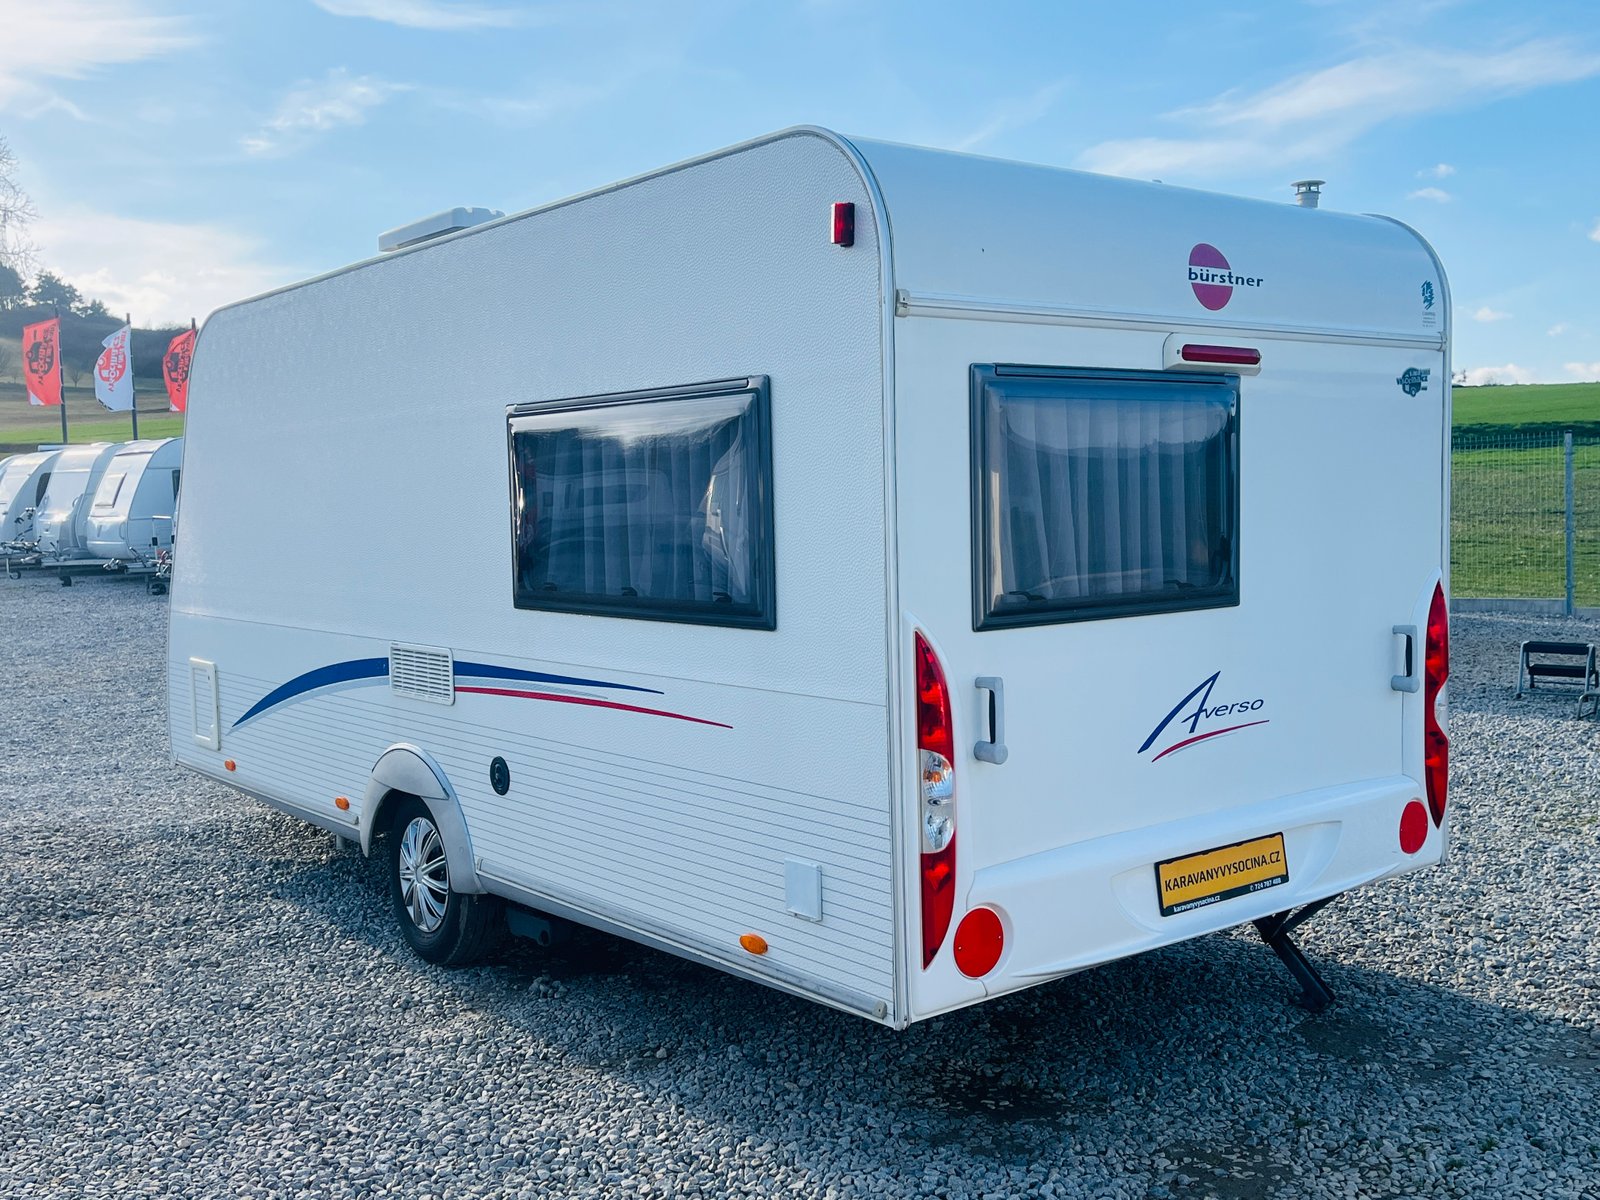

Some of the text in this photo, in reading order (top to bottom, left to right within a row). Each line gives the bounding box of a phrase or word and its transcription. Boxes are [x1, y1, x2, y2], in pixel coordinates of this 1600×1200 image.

[1188, 267, 1264, 287] bürstner
[1137, 670, 1264, 754] Averso
[1165, 850, 1281, 892] KARAVANYVYSOCINA.CZ
